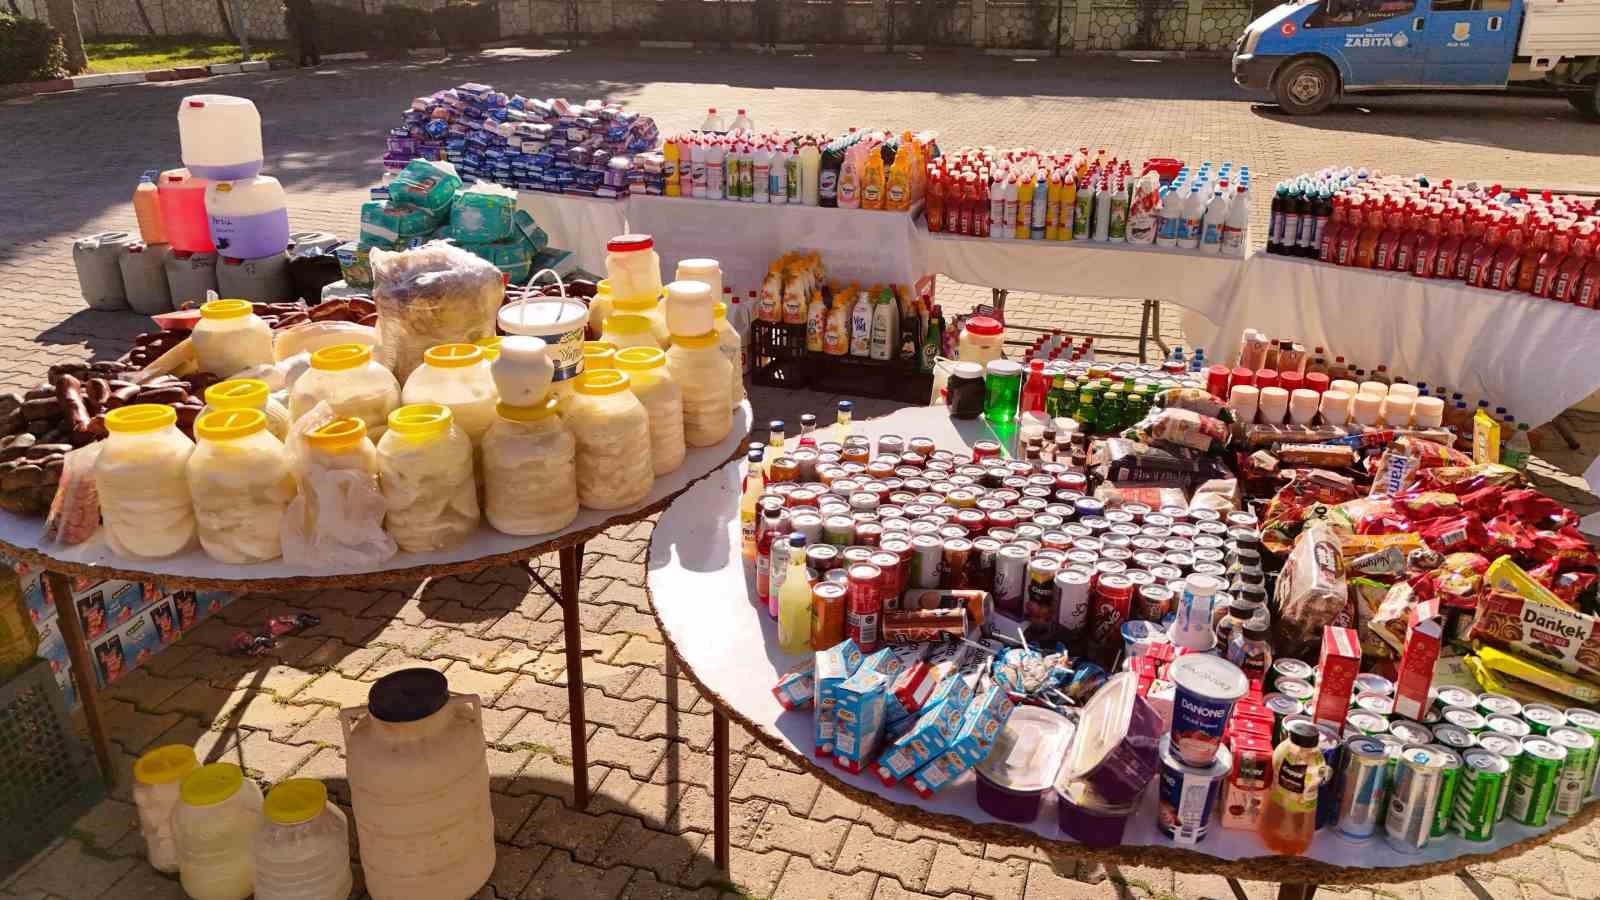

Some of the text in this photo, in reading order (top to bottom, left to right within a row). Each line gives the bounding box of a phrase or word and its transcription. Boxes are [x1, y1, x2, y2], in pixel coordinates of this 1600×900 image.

[1344, 37, 1392, 48] ZABITA
[1523, 608, 1586, 640] Dankek
[1181, 698, 1225, 718] DANONE
